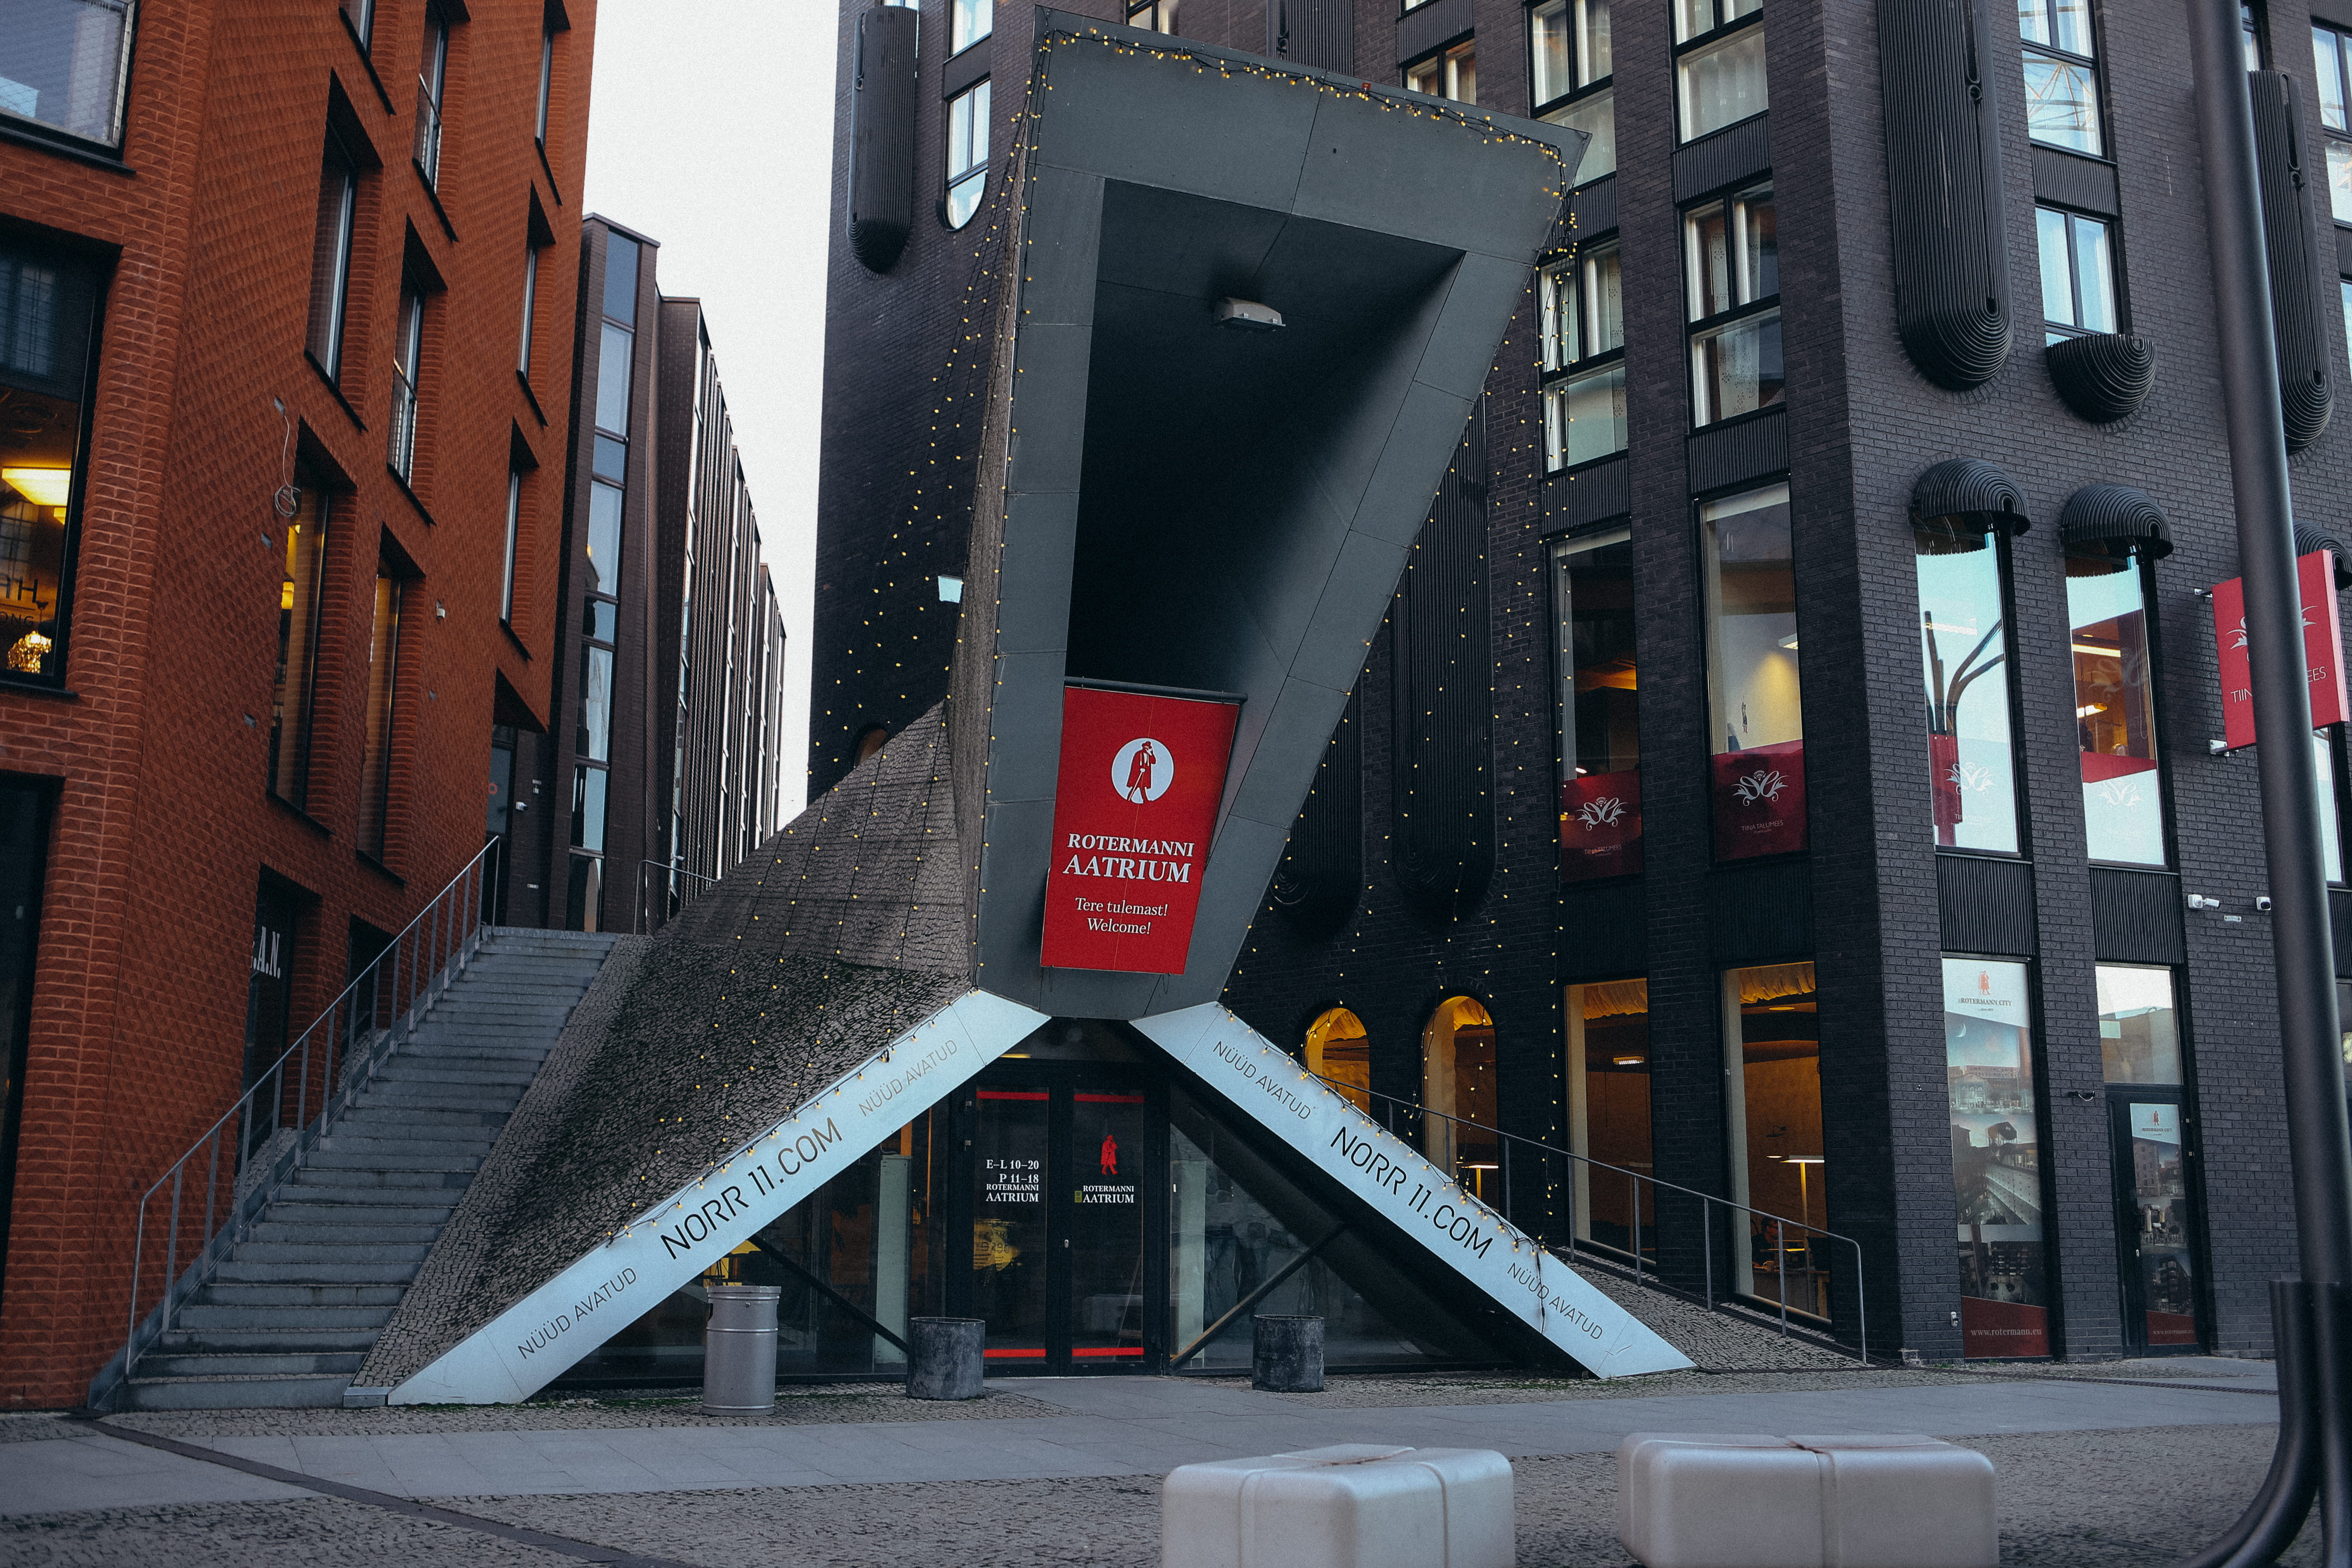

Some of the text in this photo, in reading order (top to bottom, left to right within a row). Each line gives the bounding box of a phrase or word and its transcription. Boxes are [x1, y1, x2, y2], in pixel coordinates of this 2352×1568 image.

[1757, 820, 1783, 829] TALUMEES
[1067, 833, 1194, 857] ROTERMANNI
[1063, 854, 1191, 882] AATRIUM
[1075, 897, 1169, 916] Tere tulemast!
[1087, 918, 1152, 934] Welcome!
[858, 1040, 957, 1117] NÜÜD AVATUD
[1213, 1041, 1311, 1119] NÜÜD AVATUD
[1330, 1126, 1407, 1196] NORR
[999, 1173, 1007, 1182] P
[986, 1192, 1039, 1202] AATRIUM
[1083, 1194, 1134, 1203] AATRIUM
[660, 1185, 749, 1260] NORR
[1507, 1262, 1603, 1339] NÜÜD AVATUD
[518, 1268, 637, 1360] NÜÜD AVATUD
[1971, 1328, 2042, 1336] www.rotermann.eu
